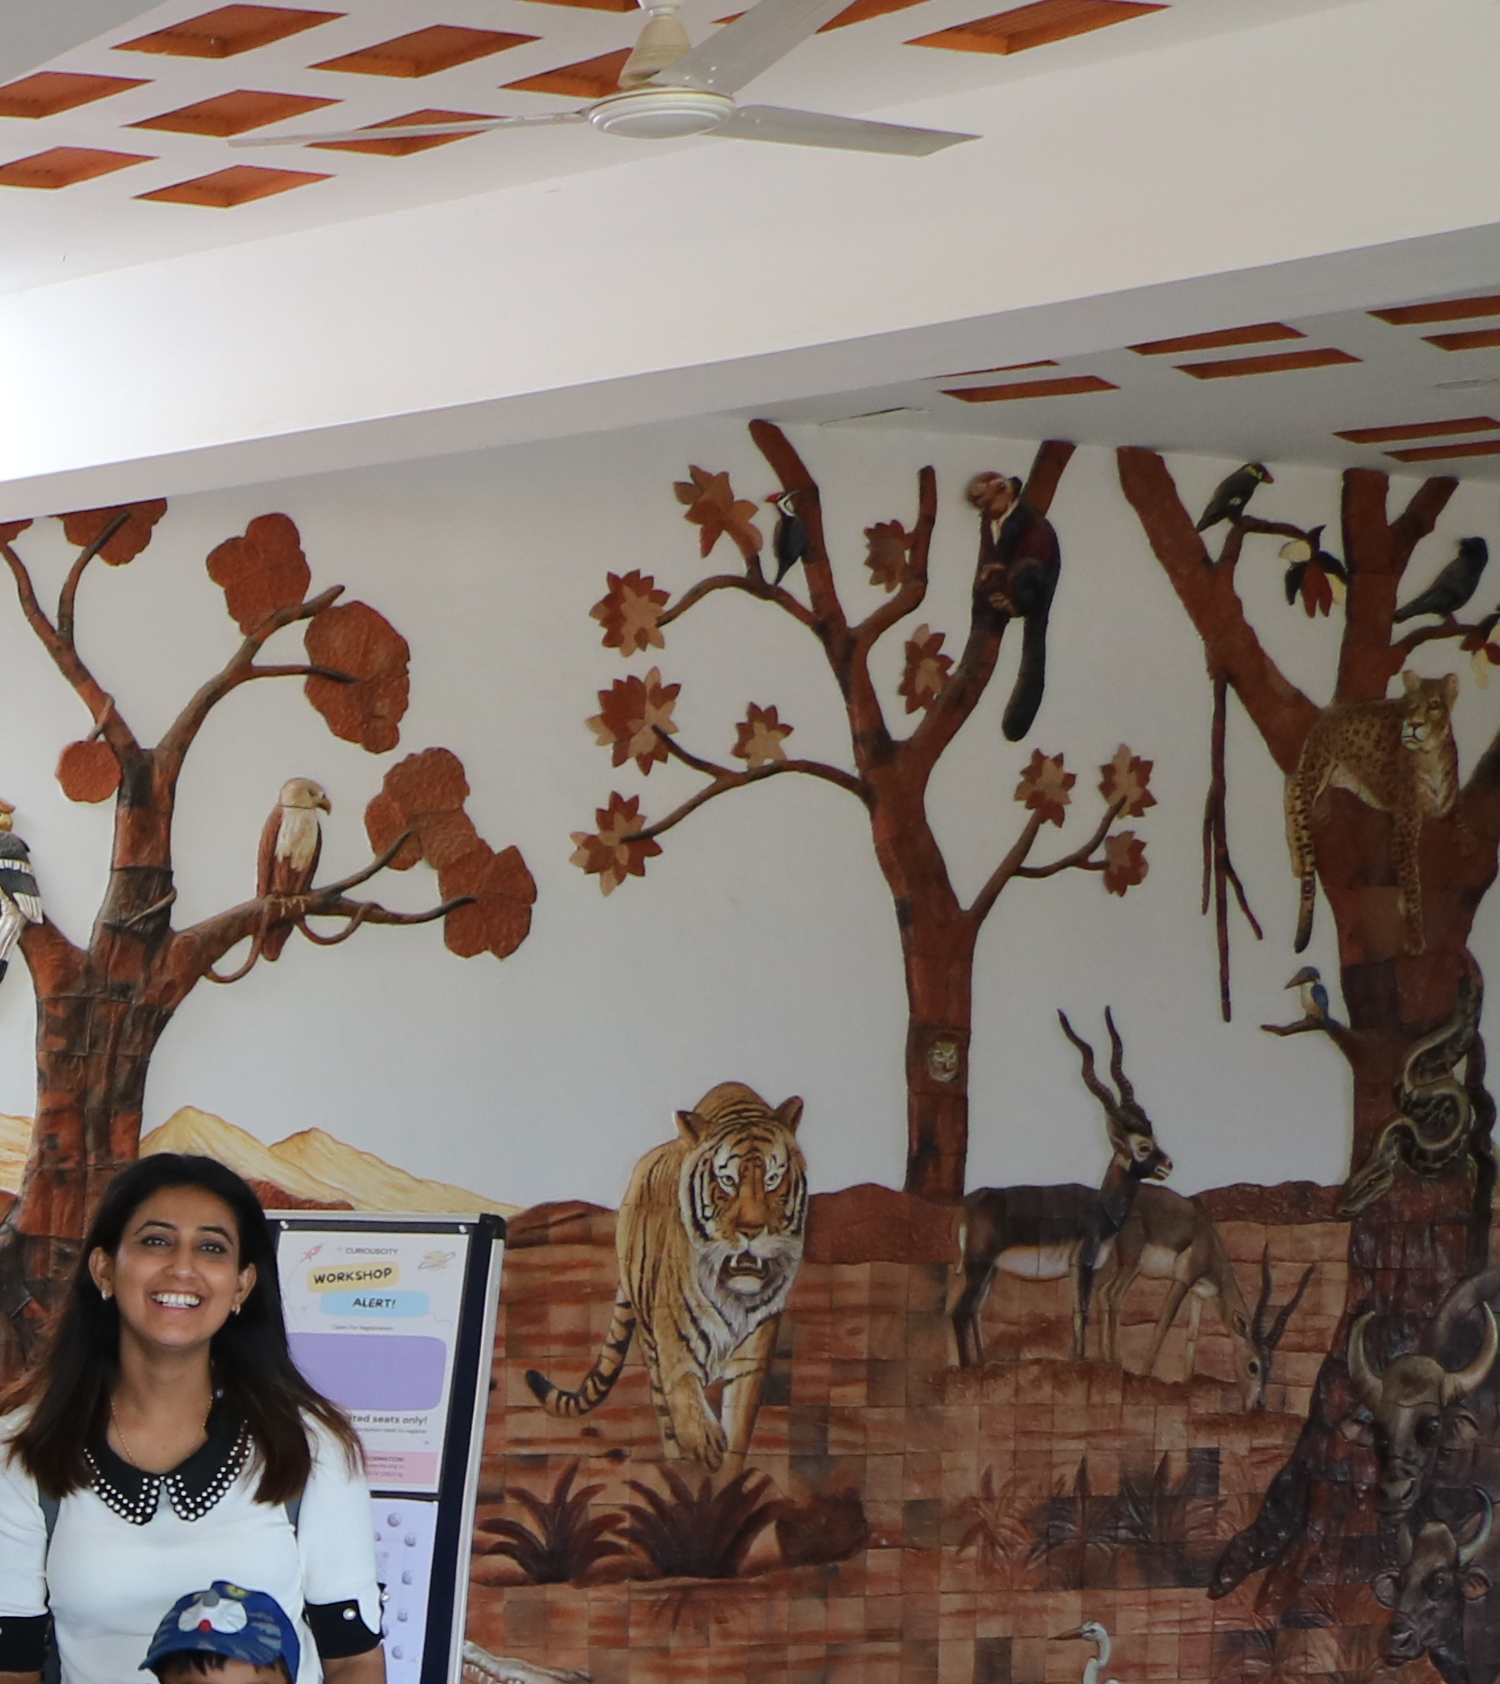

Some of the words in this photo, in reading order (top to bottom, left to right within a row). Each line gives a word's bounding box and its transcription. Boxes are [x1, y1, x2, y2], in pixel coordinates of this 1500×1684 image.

[313, 1266, 393, 1285] WORKSHOP
[352, 1297, 397, 1309] ALERT!
[372, 1415, 400, 1424] seats
[402, 1415, 428, 1426] only!
